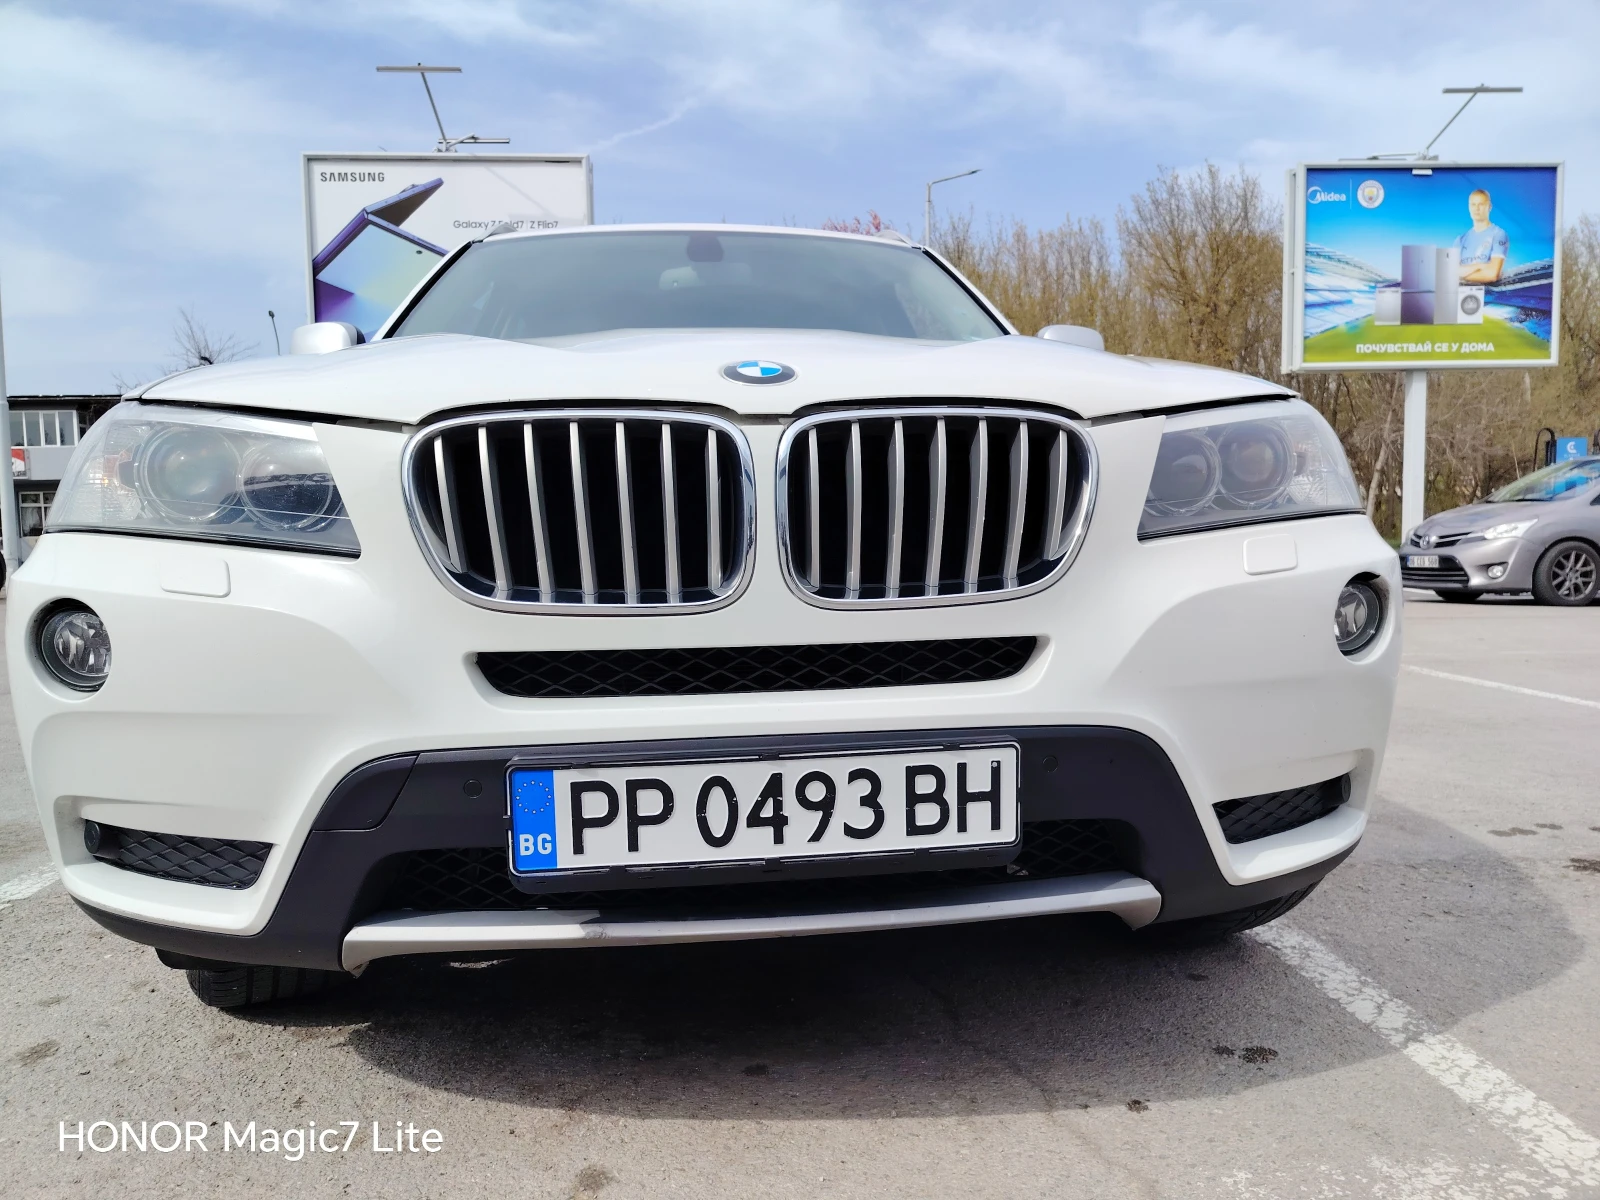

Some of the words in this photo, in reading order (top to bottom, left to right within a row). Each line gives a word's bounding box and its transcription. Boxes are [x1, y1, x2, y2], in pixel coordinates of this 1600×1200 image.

[320, 171, 385, 183] SAMSUNG
[453, 219, 488, 230] Galaxy
[529, 220, 536, 229] Z
[1355, 341, 1432, 353] ПОЧУВСТВАЙ
[1433, 342, 1449, 352] СЕ
[1451, 342, 1460, 352] У
[1461, 342, 1495, 353] ДОМА
[570, 778, 674, 855] PP
[695, 768, 885, 847] 0493
[905, 760, 1002, 836] BH
[518, 833, 552, 856] BG
